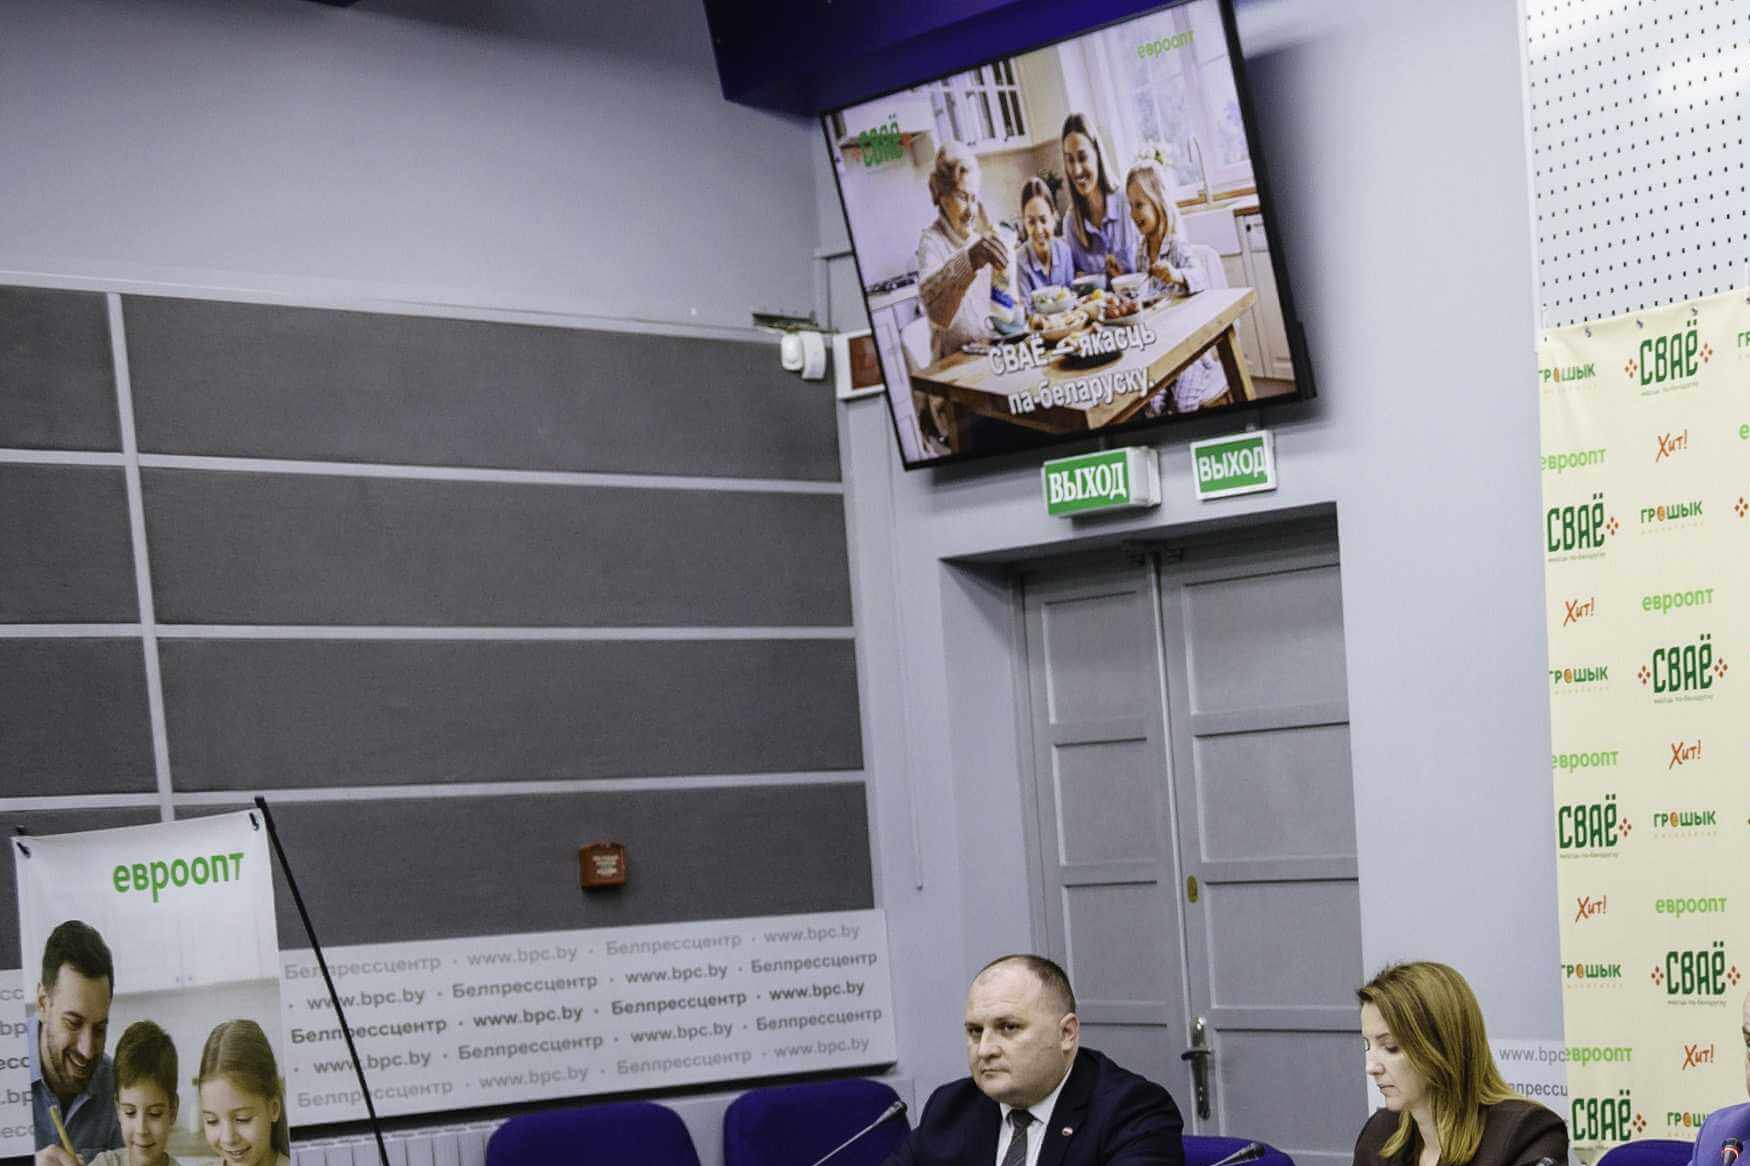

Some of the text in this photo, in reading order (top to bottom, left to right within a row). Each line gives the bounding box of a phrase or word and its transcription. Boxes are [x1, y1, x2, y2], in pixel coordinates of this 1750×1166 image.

[989, 323, 1157, 375] СВАЁ якасць
[1639, 318, 1699, 387] СВАЁ
[1008, 366, 1156, 417] па-беларуску.
[1198, 443, 1267, 483] ВЫХОД
[1655, 428, 1688, 464] Хит!
[1048, 462, 1127, 505] ВЫХОД
[1546, 491, 1606, 553] СВАЁ
[1640, 500, 1704, 524] ГРОШЫК
[1562, 596, 1595, 628] Хит!
[1641, 588, 1713, 617] евроопт
[1652, 632, 1714, 694] СВАЁ
[1552, 751, 1617, 769] евроопт
[1668, 738, 1702, 771] Хит!
[1557, 793, 1619, 850] СВАЁ
[1653, 809, 1717, 829] ГРОШЫК
[112, 851, 246, 904] евроопт
[1574, 894, 1607, 925] Хит!
[1654, 896, 1727, 914] евроопт
[466, 923, 861, 967] www.bpc.by Белпрессцентр www.bpc.by
[1665, 940, 1727, 996] СВАЁ
[451, 973, 599, 999] Белпрессцентр
[624, 962, 729, 985] www.bpc.by
[750, 950, 878, 975] Белпрессцентр
[472, 1004, 584, 1027] www.bpc.by
[610, 990, 748, 1016] Белпрессцентр
[769, 979, 865, 1002] www.bpc.by
[458, 1006, 883, 1061] Белпрессцентр www.bpc.by Белпрессцентр
[479, 1036, 871, 1089] www.bpc.by Белпрессцентр www.bpc.by
[1681, 1043, 1715, 1072] Хит!
[1571, 1088, 1633, 1143] СВАЁ
